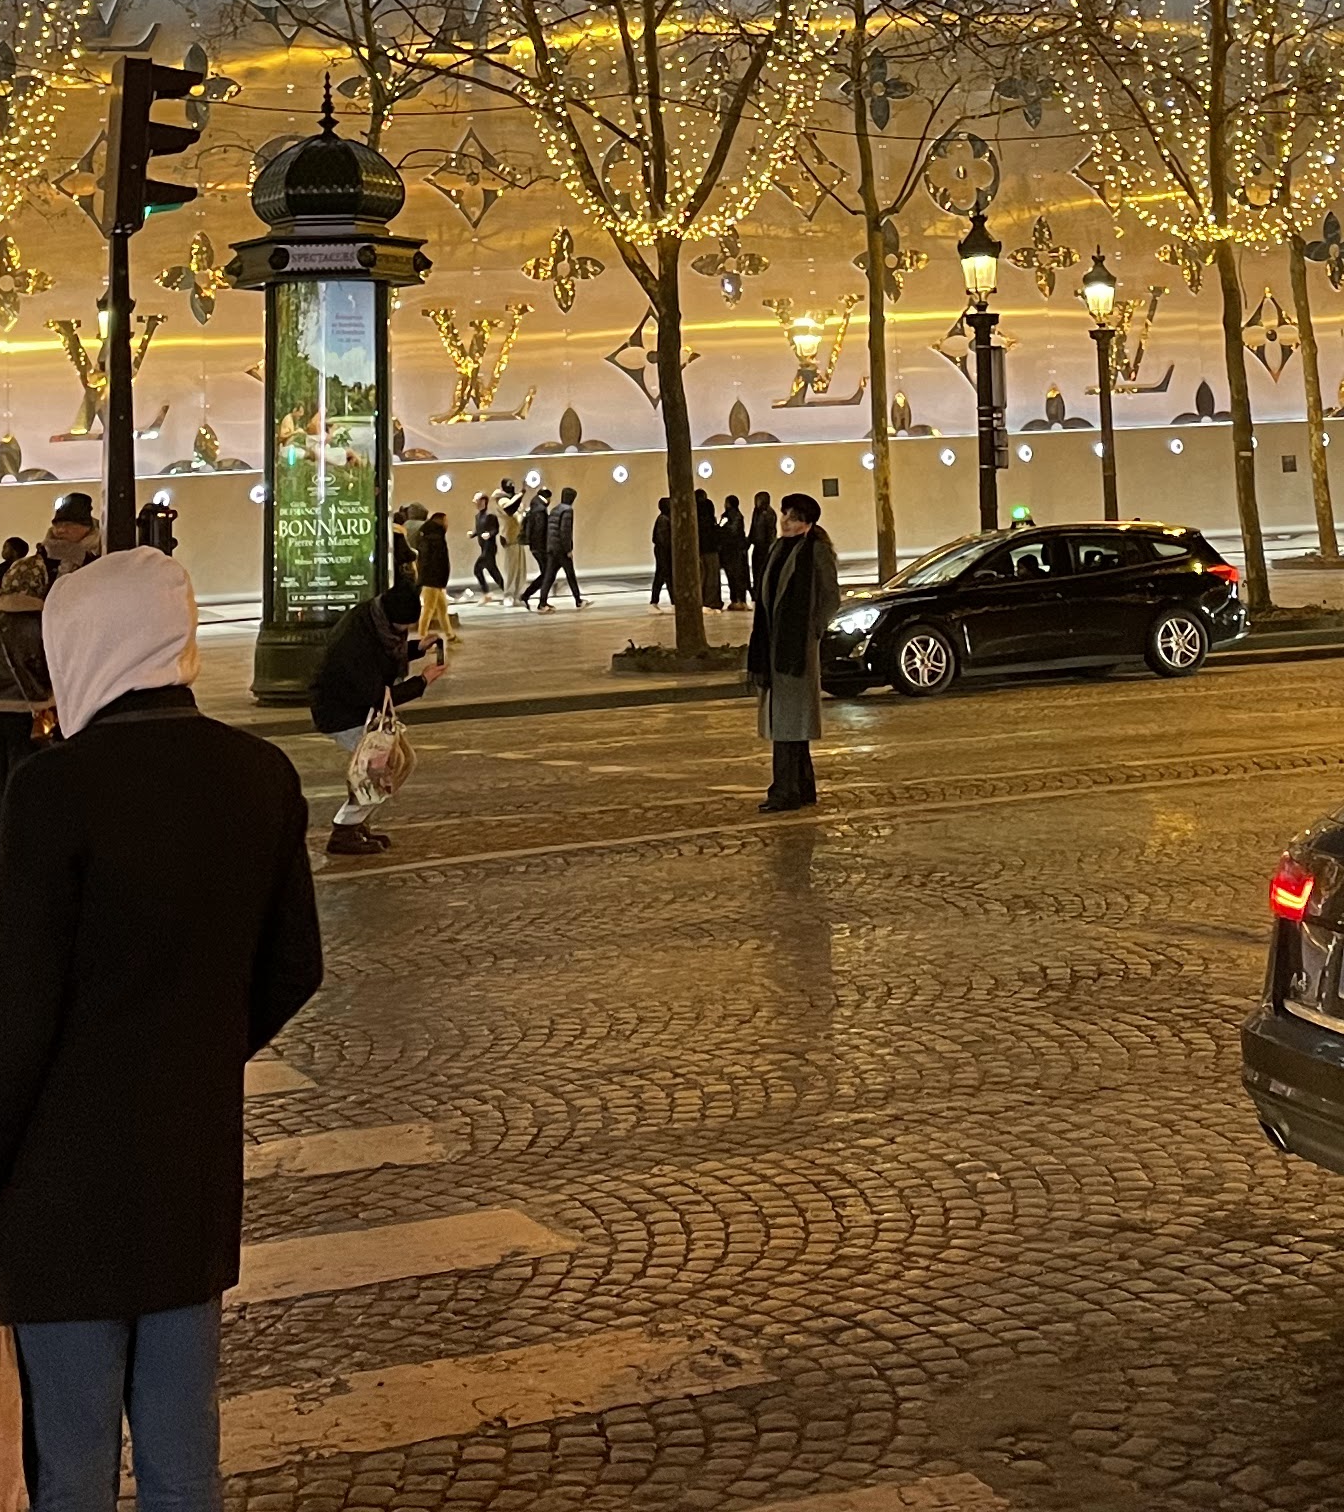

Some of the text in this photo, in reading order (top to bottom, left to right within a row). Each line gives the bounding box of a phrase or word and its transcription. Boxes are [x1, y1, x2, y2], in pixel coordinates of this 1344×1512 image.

[278, 517, 372, 537] BONNARD
[288, 535, 361, 548] Pierre et Marthe
